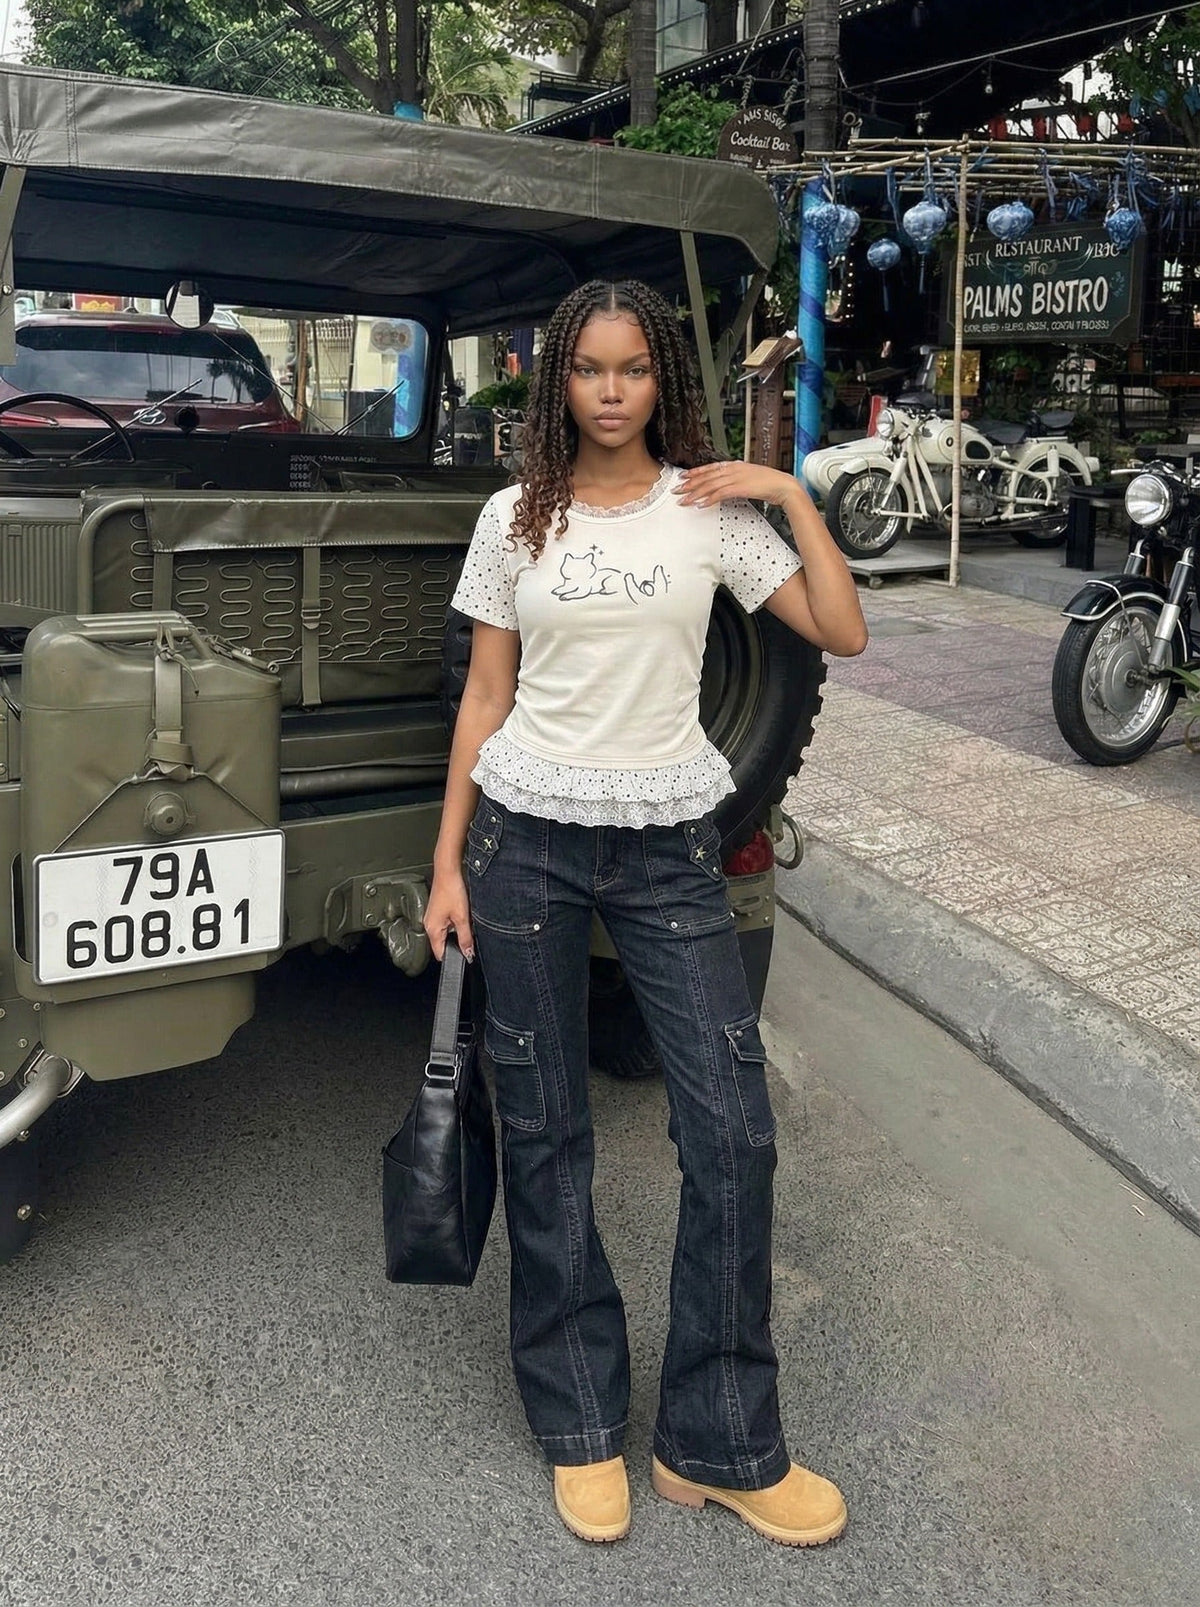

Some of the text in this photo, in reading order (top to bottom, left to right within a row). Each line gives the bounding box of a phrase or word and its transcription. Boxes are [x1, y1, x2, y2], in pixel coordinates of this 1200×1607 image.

[730, 131, 791, 151] Cocktail Bar
[995, 236, 1083, 258] RESTAURANT
[963, 276, 1109, 320] PALMS BISTRO
[113, 848, 215, 905] 79A
[66, 898, 250, 969] 608.81
